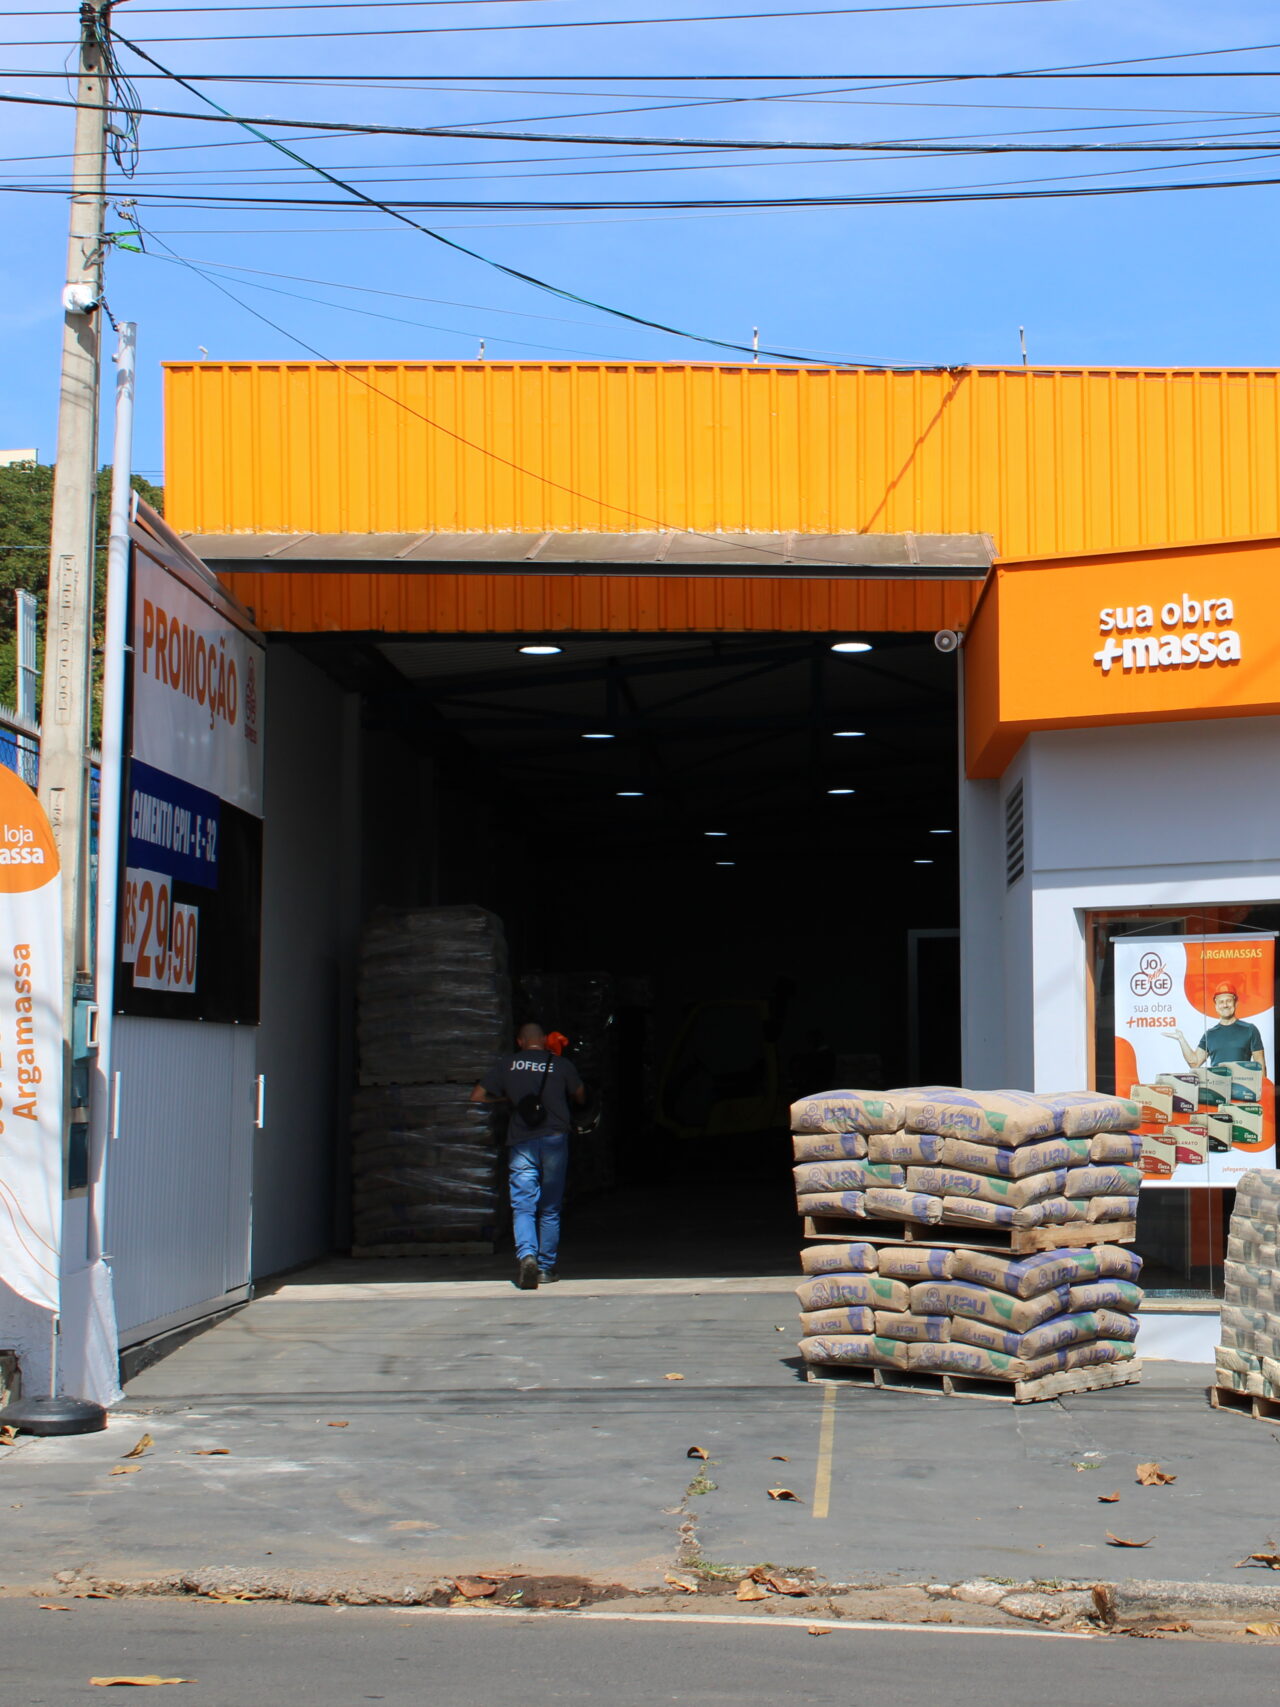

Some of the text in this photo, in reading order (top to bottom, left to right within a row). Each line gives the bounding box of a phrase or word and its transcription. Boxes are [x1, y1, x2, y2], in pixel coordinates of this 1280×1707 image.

[1099, 593, 1234, 632] sua obra
[1093, 630, 1242, 671] +massa
[142, 598, 237, 730] PROMOÇÃO
[4, 824, 34, 846] loja
[131, 789, 173, 849] CIMENTO
[206, 818, 217, 863] 32
[0, 847, 45, 864] assa
[1200, 948, 1263, 959] ARGAMASSAS
[1144, 959, 1158, 970] JO
[1134, 979, 1169, 990] FE GE
[1133, 1002, 1172, 1013] sua obra
[12, 943, 42, 1121] Argamassa
[1126, 1016, 1177, 1029] +massa
